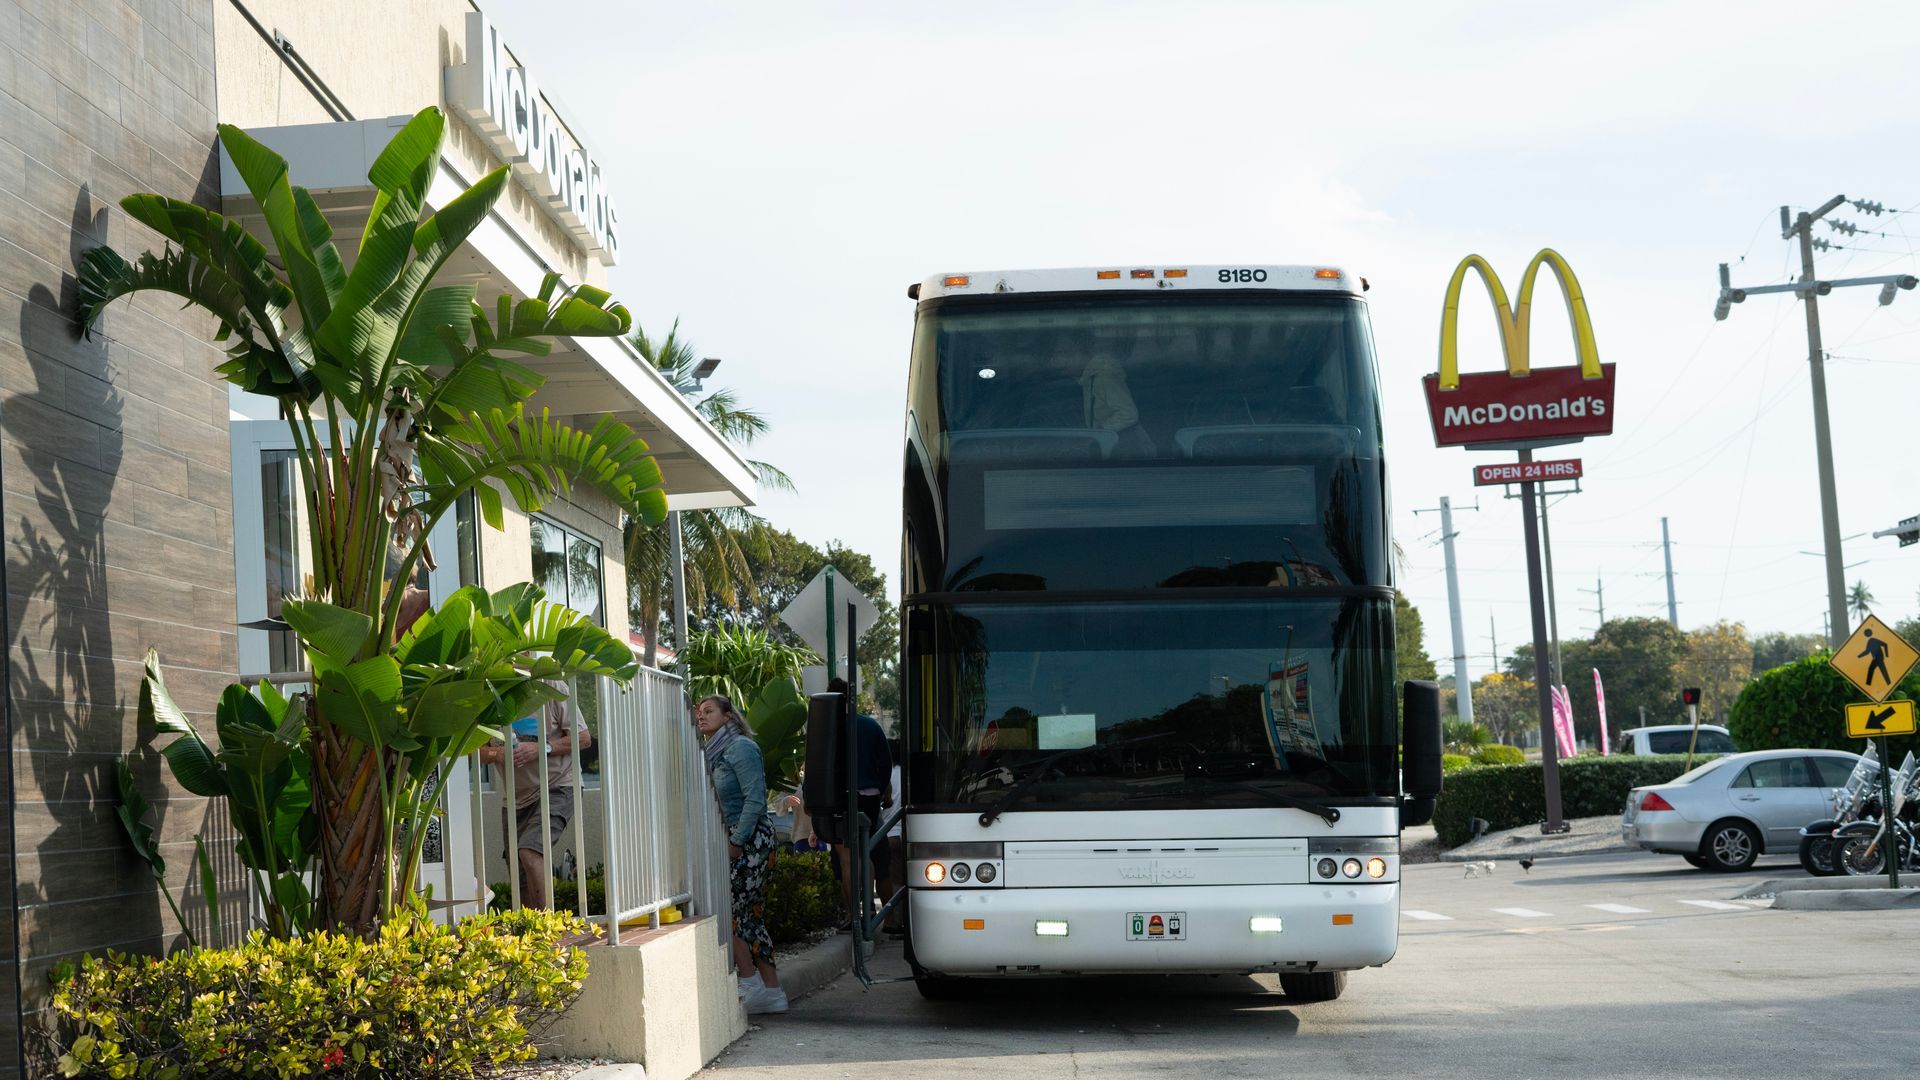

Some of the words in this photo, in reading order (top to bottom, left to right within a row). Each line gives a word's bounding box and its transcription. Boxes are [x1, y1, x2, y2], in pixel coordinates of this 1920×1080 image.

[1218, 269, 1267, 283] 8180
[1443, 396, 1606, 427] McDonald's
[1482, 465, 1521, 480] OPEN
[1525, 465, 1542, 478] 24
[1545, 462, 1579, 475] HRS.
